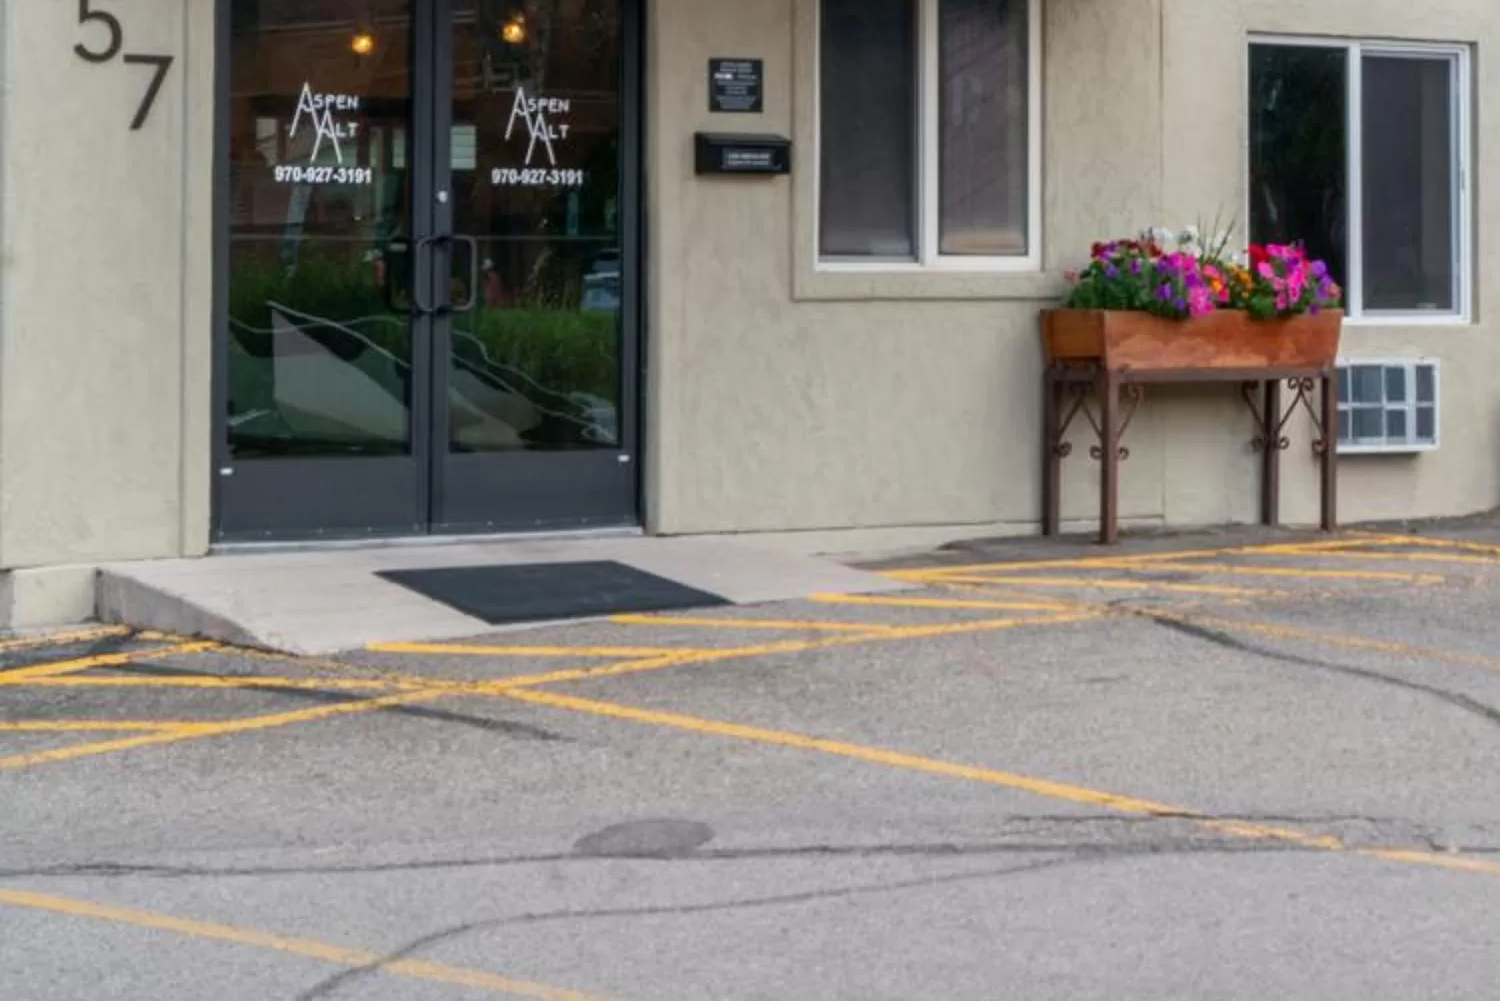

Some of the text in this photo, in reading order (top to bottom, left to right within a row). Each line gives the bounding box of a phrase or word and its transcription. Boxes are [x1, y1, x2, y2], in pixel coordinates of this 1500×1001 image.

[290, 82, 359, 137] ASPEN
[310, 109, 359, 164] ALT
[504, 86, 570, 140] ASPEN
[525, 112, 570, 165] ALT
[275, 166, 372, 184] 970-927-3191
